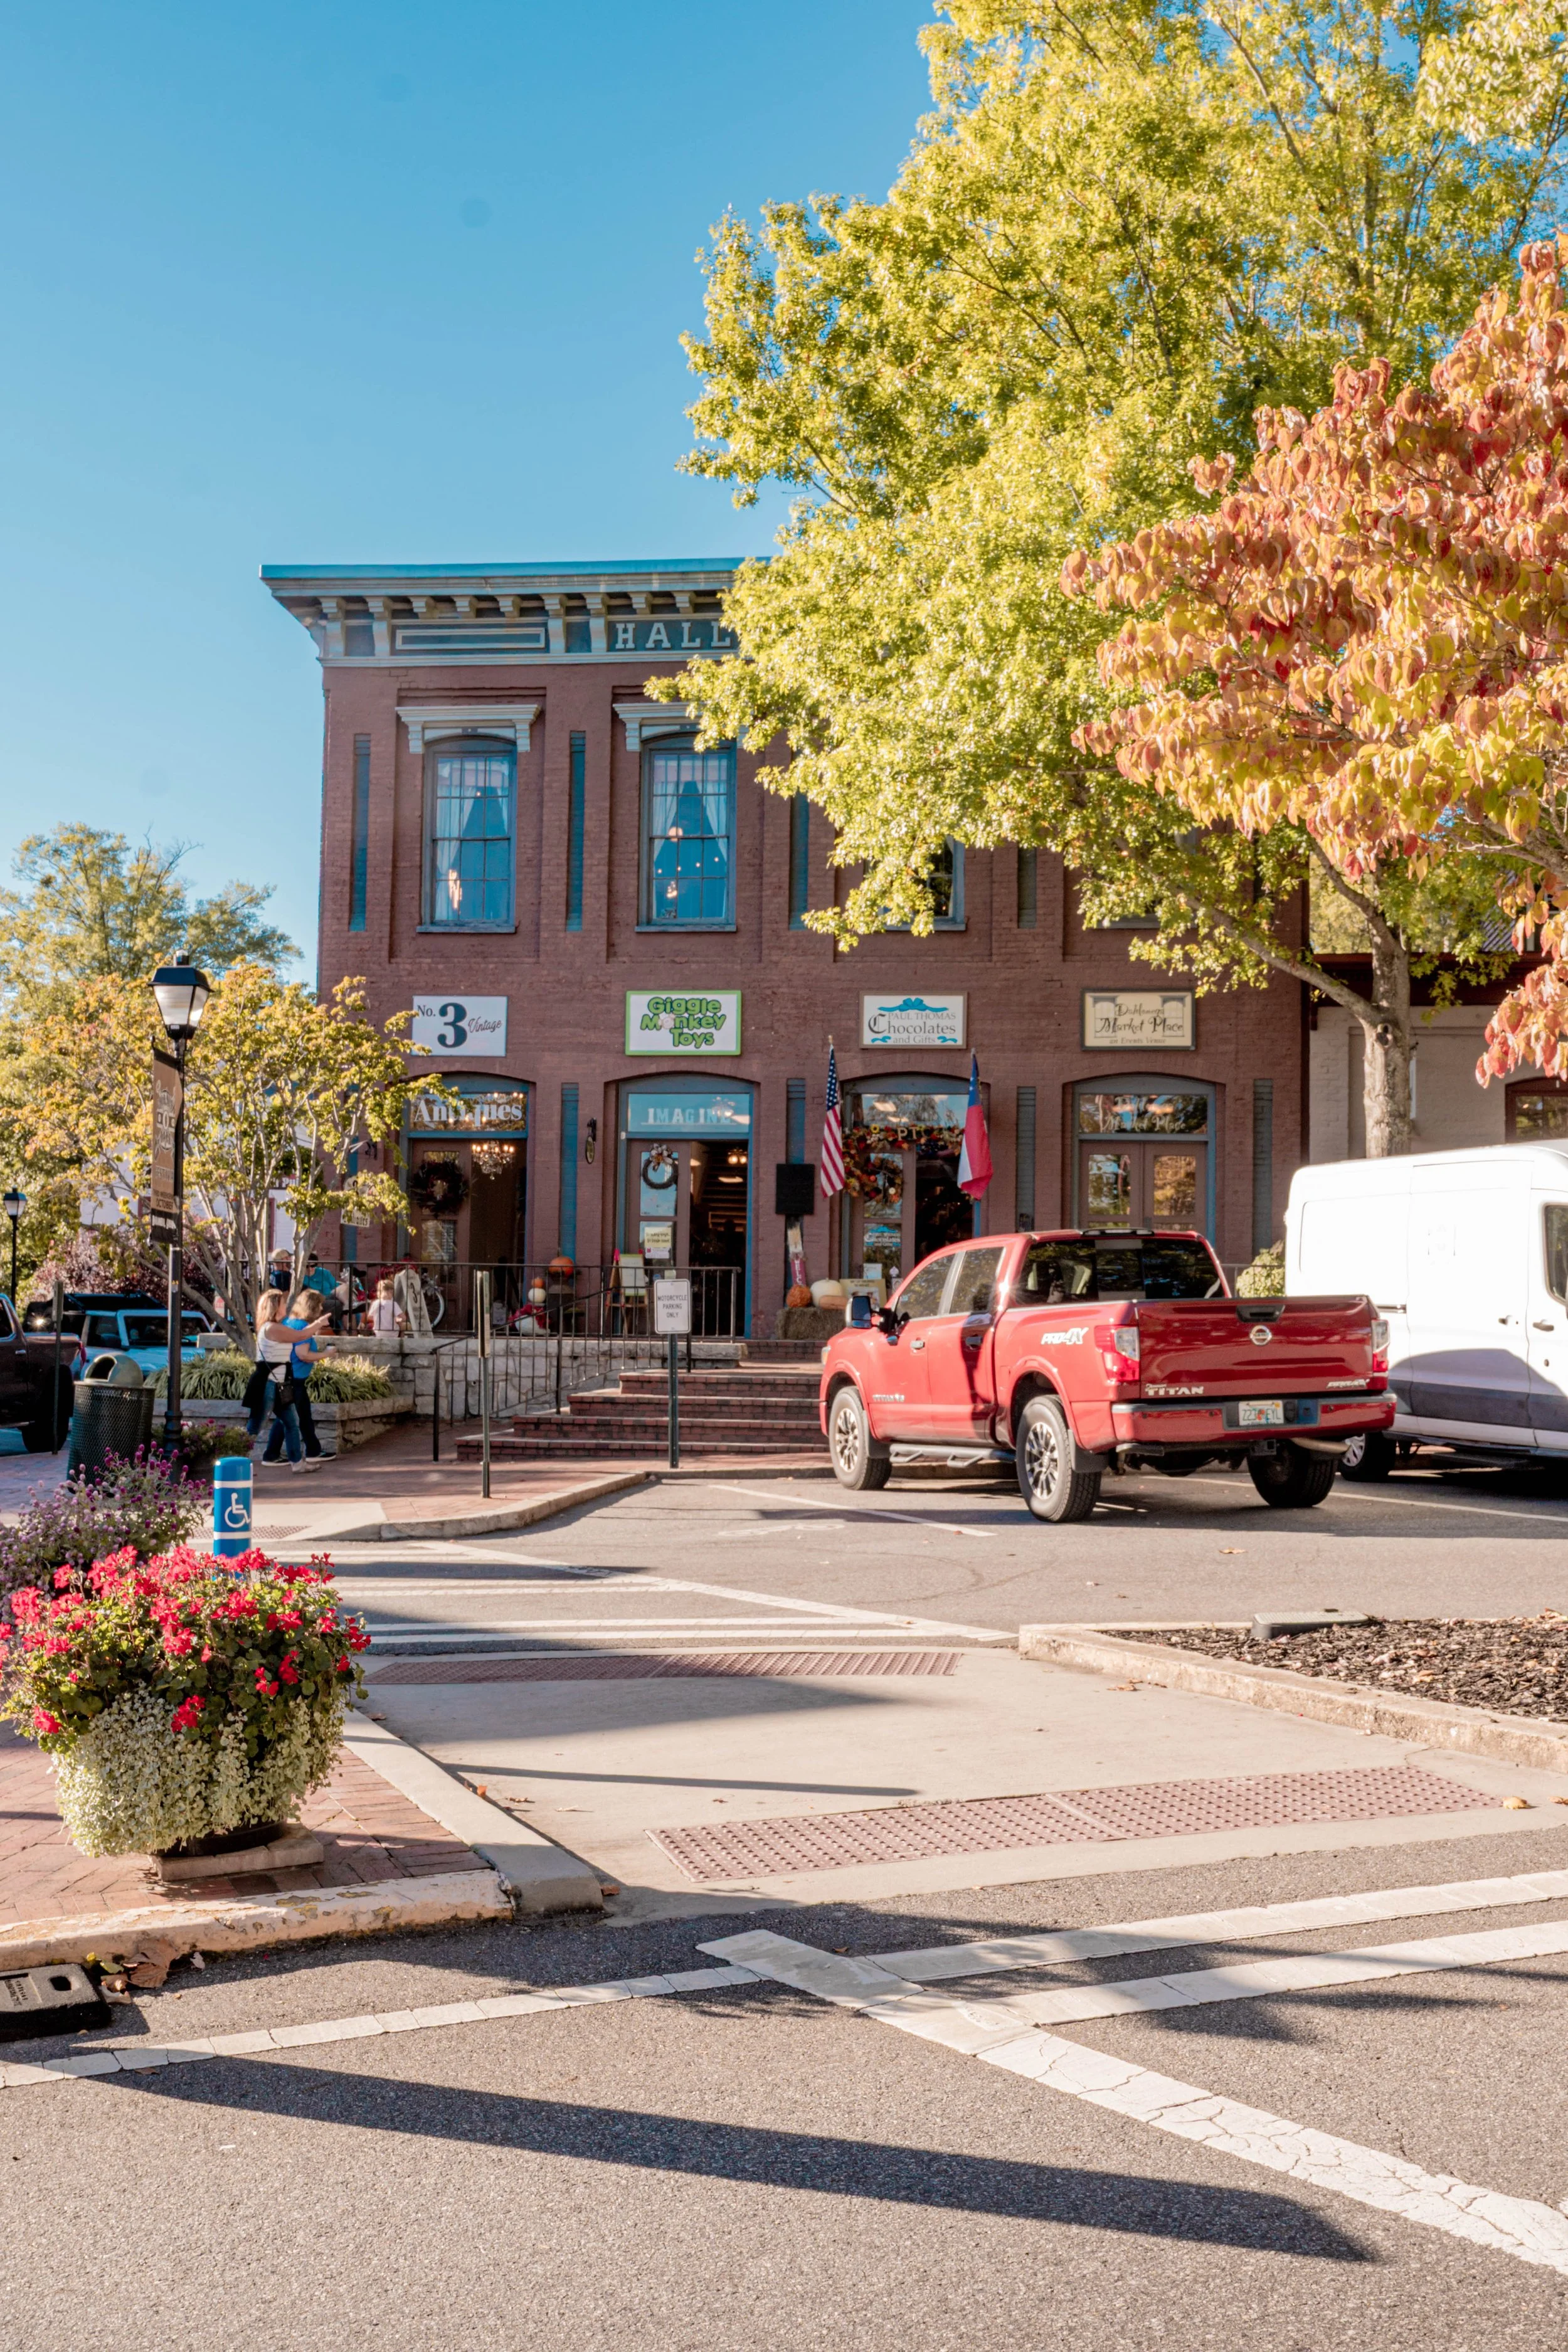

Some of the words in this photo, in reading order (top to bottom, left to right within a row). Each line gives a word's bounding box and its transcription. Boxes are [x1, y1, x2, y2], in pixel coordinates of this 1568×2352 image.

[647, 997, 721, 1015] Giggle
[417, 1005, 436, 1017] No.
[437, 1002, 467, 1048] 3
[468, 1016, 502, 1033] Vintage
[868, 1014, 956, 1034] Chocolates
[888, 1012, 913, 1020] PAUL
[915, 1012, 956, 1020] THOMAS
[1096, 1017, 1144, 1034] Market
[1148, 1015, 1184, 1034] Place
[669, 1028, 714, 1049] Toys
[893, 1036, 909, 1044] and
[913, 1035, 936, 1044] Gifts
[1145, 1385, 1204, 1396] TITAN
